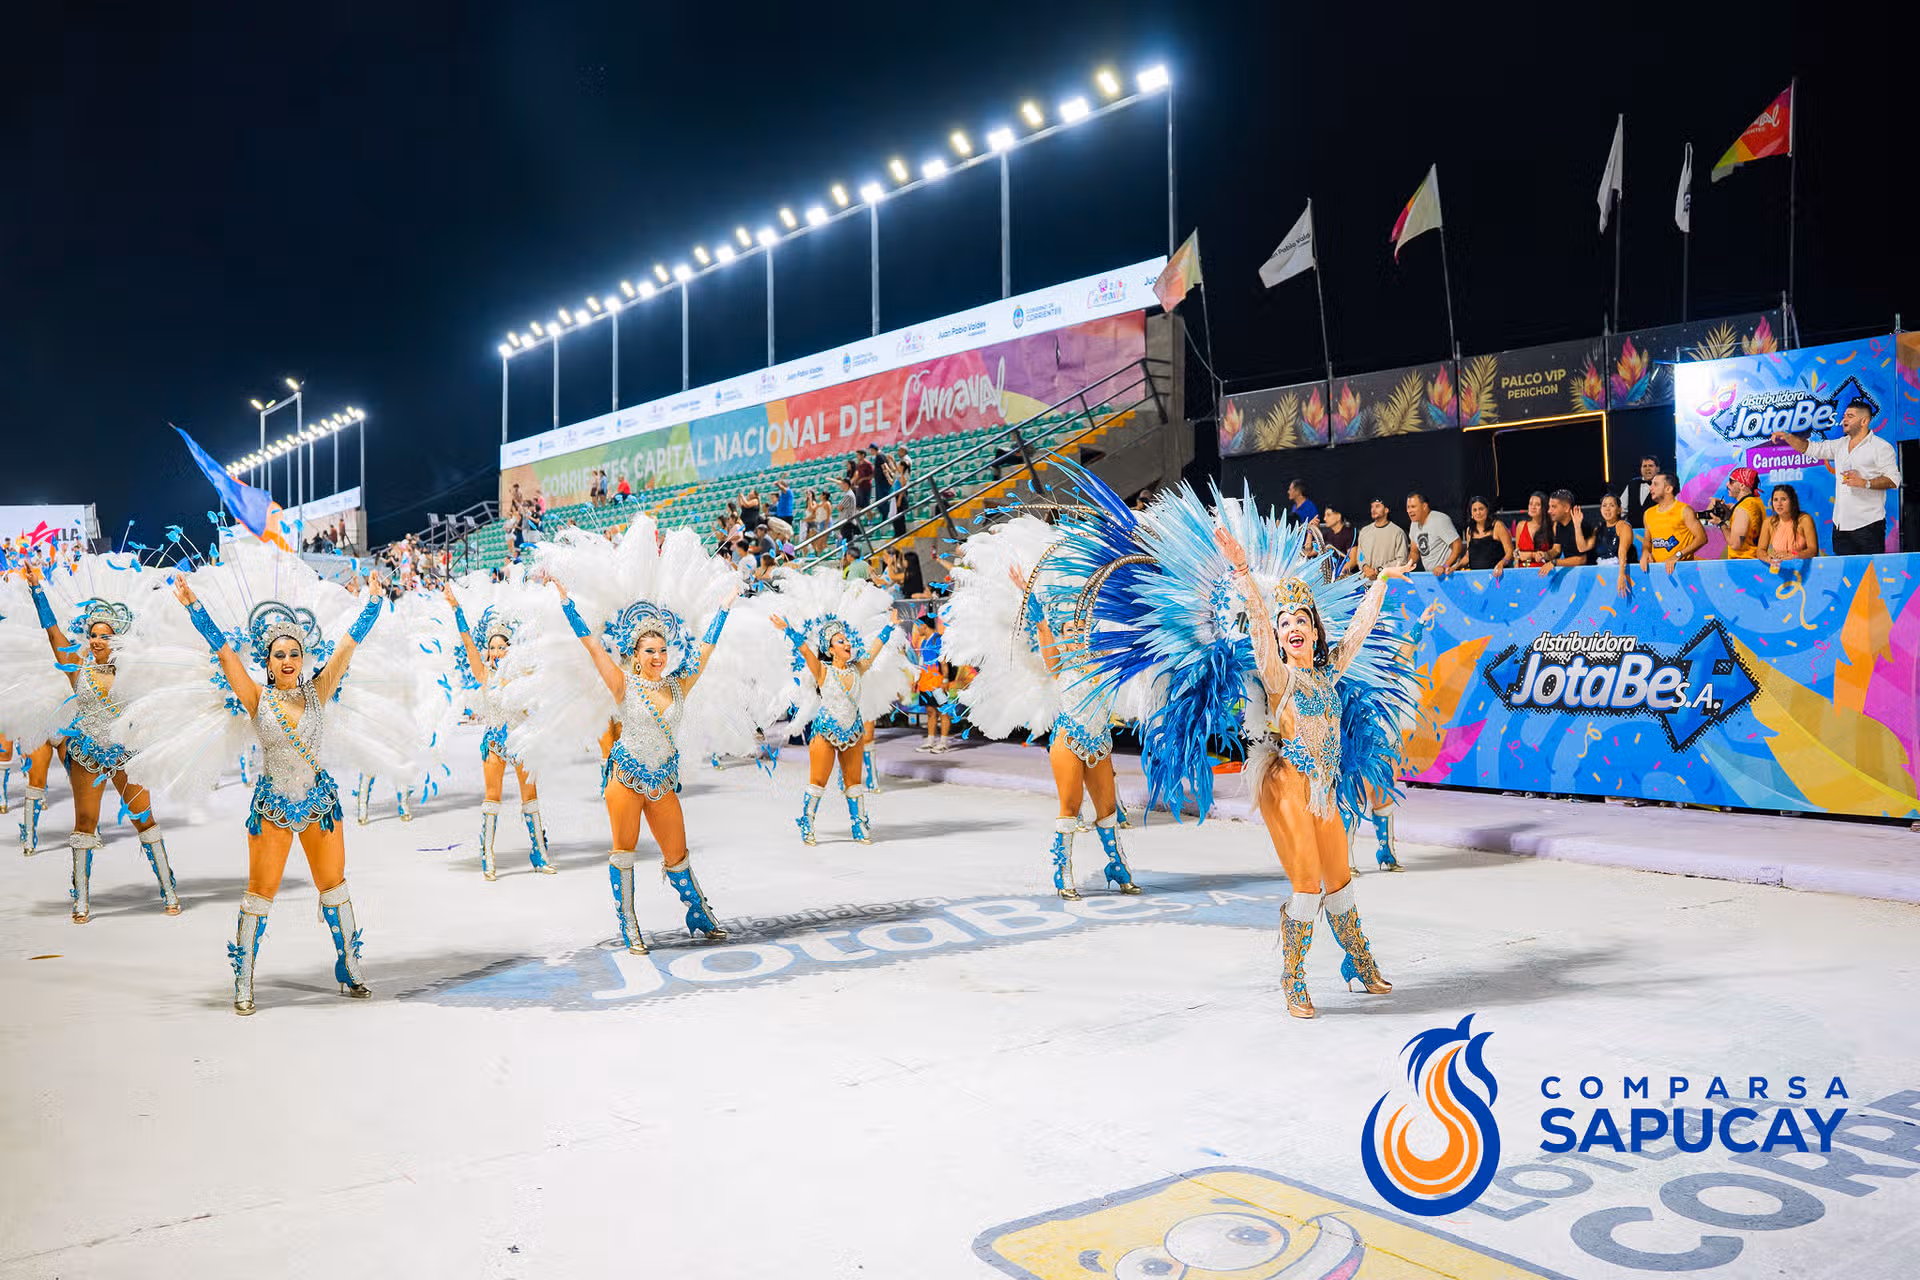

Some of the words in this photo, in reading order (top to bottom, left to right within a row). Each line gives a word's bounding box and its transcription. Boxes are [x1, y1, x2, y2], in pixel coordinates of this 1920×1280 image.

[1501, 372, 1543, 389] PALCO
[1544, 368, 1567, 382] VIP
[1507, 383, 1559, 400] PERICHON
[1741, 389, 1806, 407] distribuidora
[1727, 400, 1834, 438] JotaBe
[633, 440, 708, 480] CAPITAL
[714, 411, 832, 463] NACIONAL
[838, 397, 892, 438] DEL
[1752, 452, 1819, 469] Carnavales
[1532, 631, 1636, 652] distribuidora
[1511, 652, 1682, 710] JotaBe
[1672, 681, 1721, 709] S.A.
[591, 896, 1157, 1000] JotaBe
